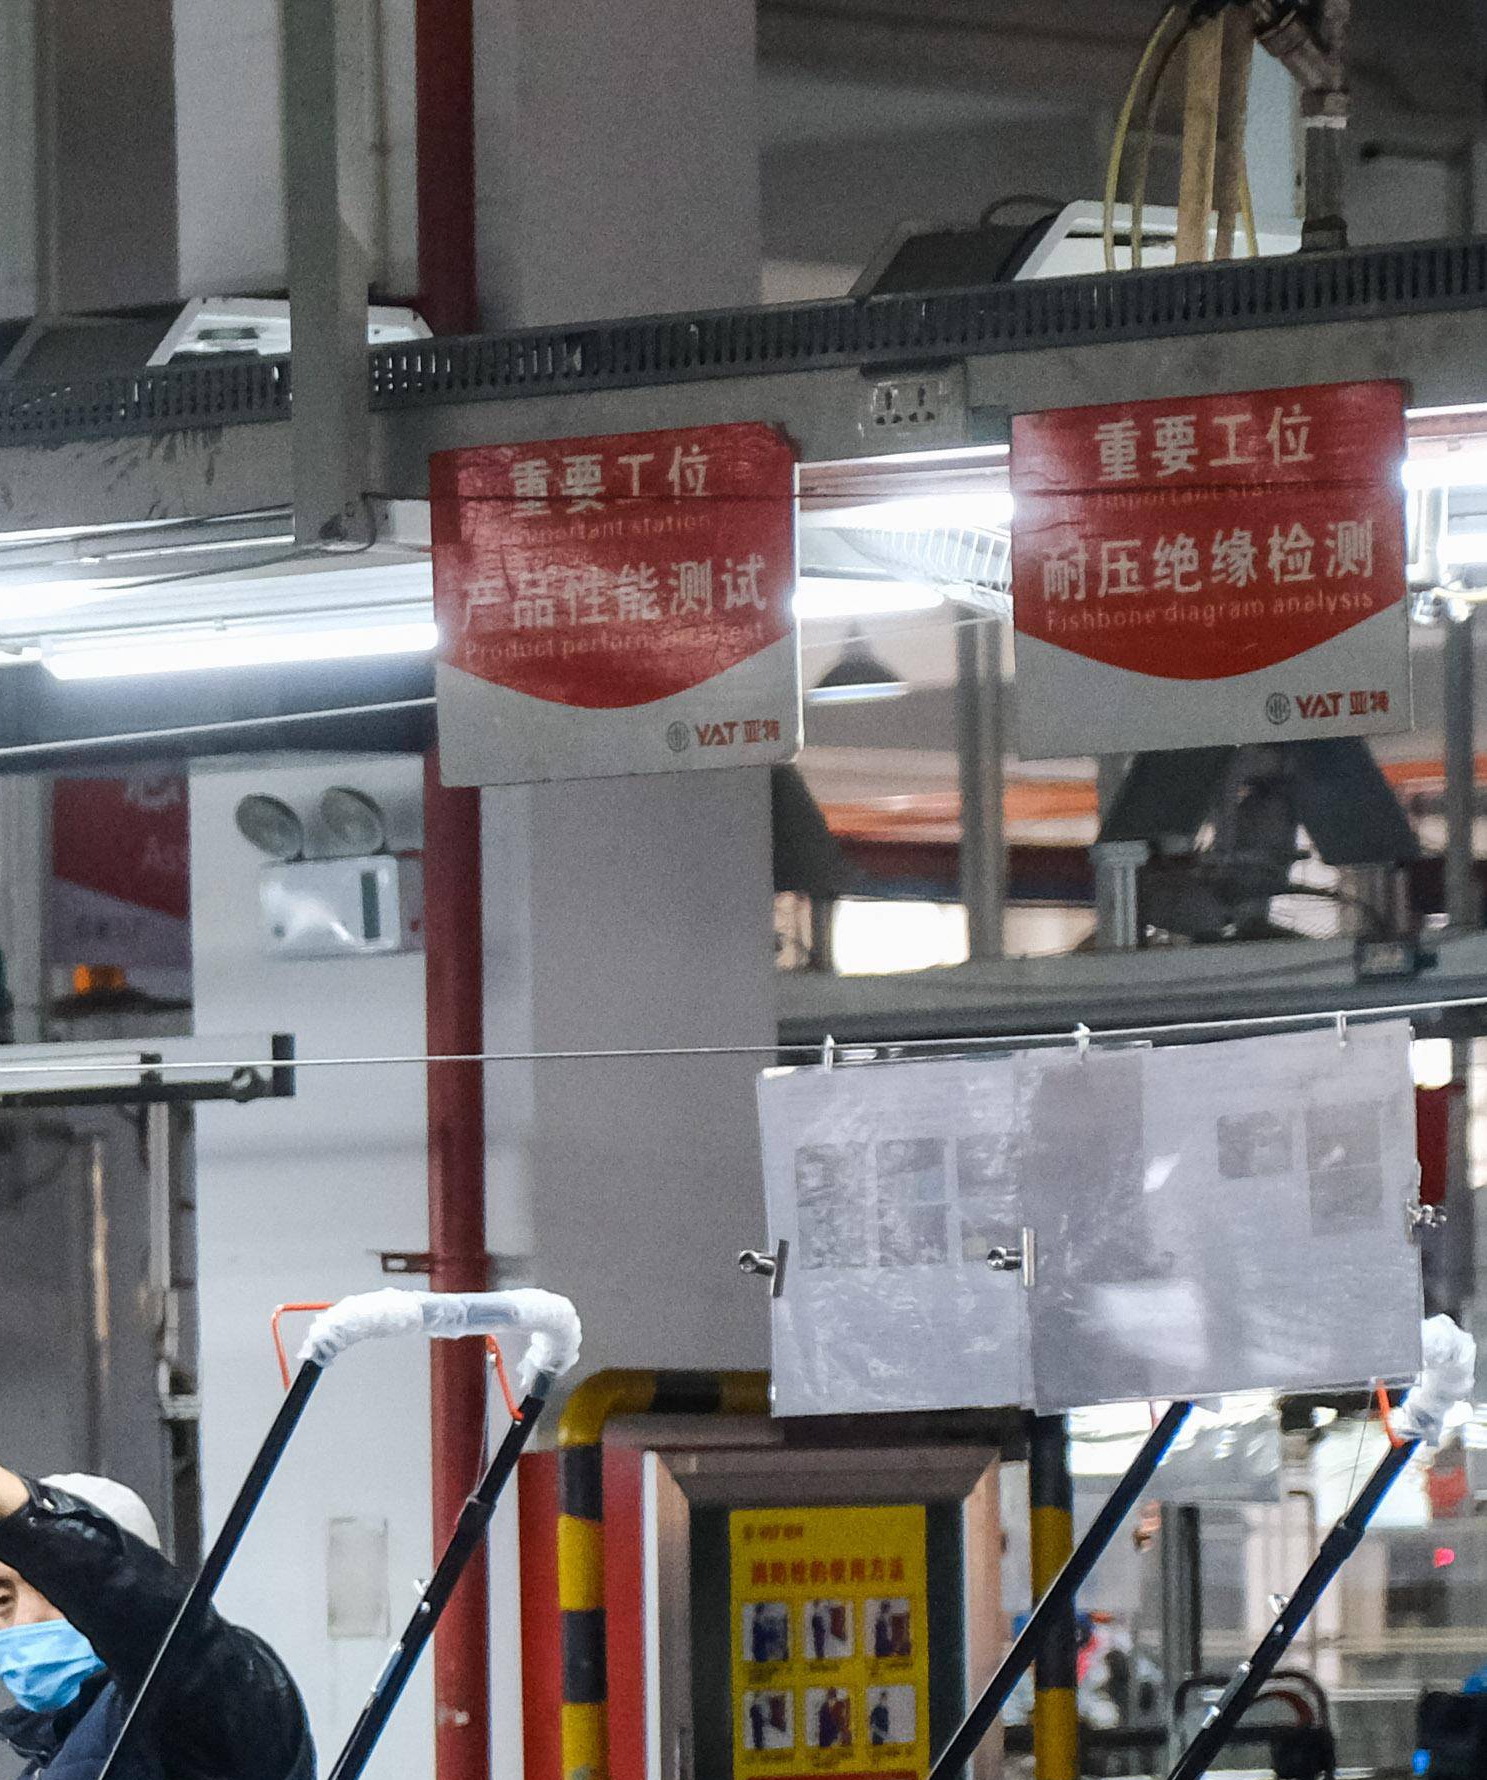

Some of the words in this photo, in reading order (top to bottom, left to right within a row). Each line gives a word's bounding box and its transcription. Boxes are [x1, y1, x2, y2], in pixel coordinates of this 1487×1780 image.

[1094, 403, 1314, 482] 重要工位
[510, 444, 711, 518] 重要工位
[465, 552, 767, 629] 产品性能测试
[1042, 519, 1375, 602] 耐压绝缘检测
[1163, 597, 1265, 628] diagram
[1272, 590, 1375, 617] analysis
[694, 720, 739, 747] YAT
[1295, 692, 1344, 719] YAT
